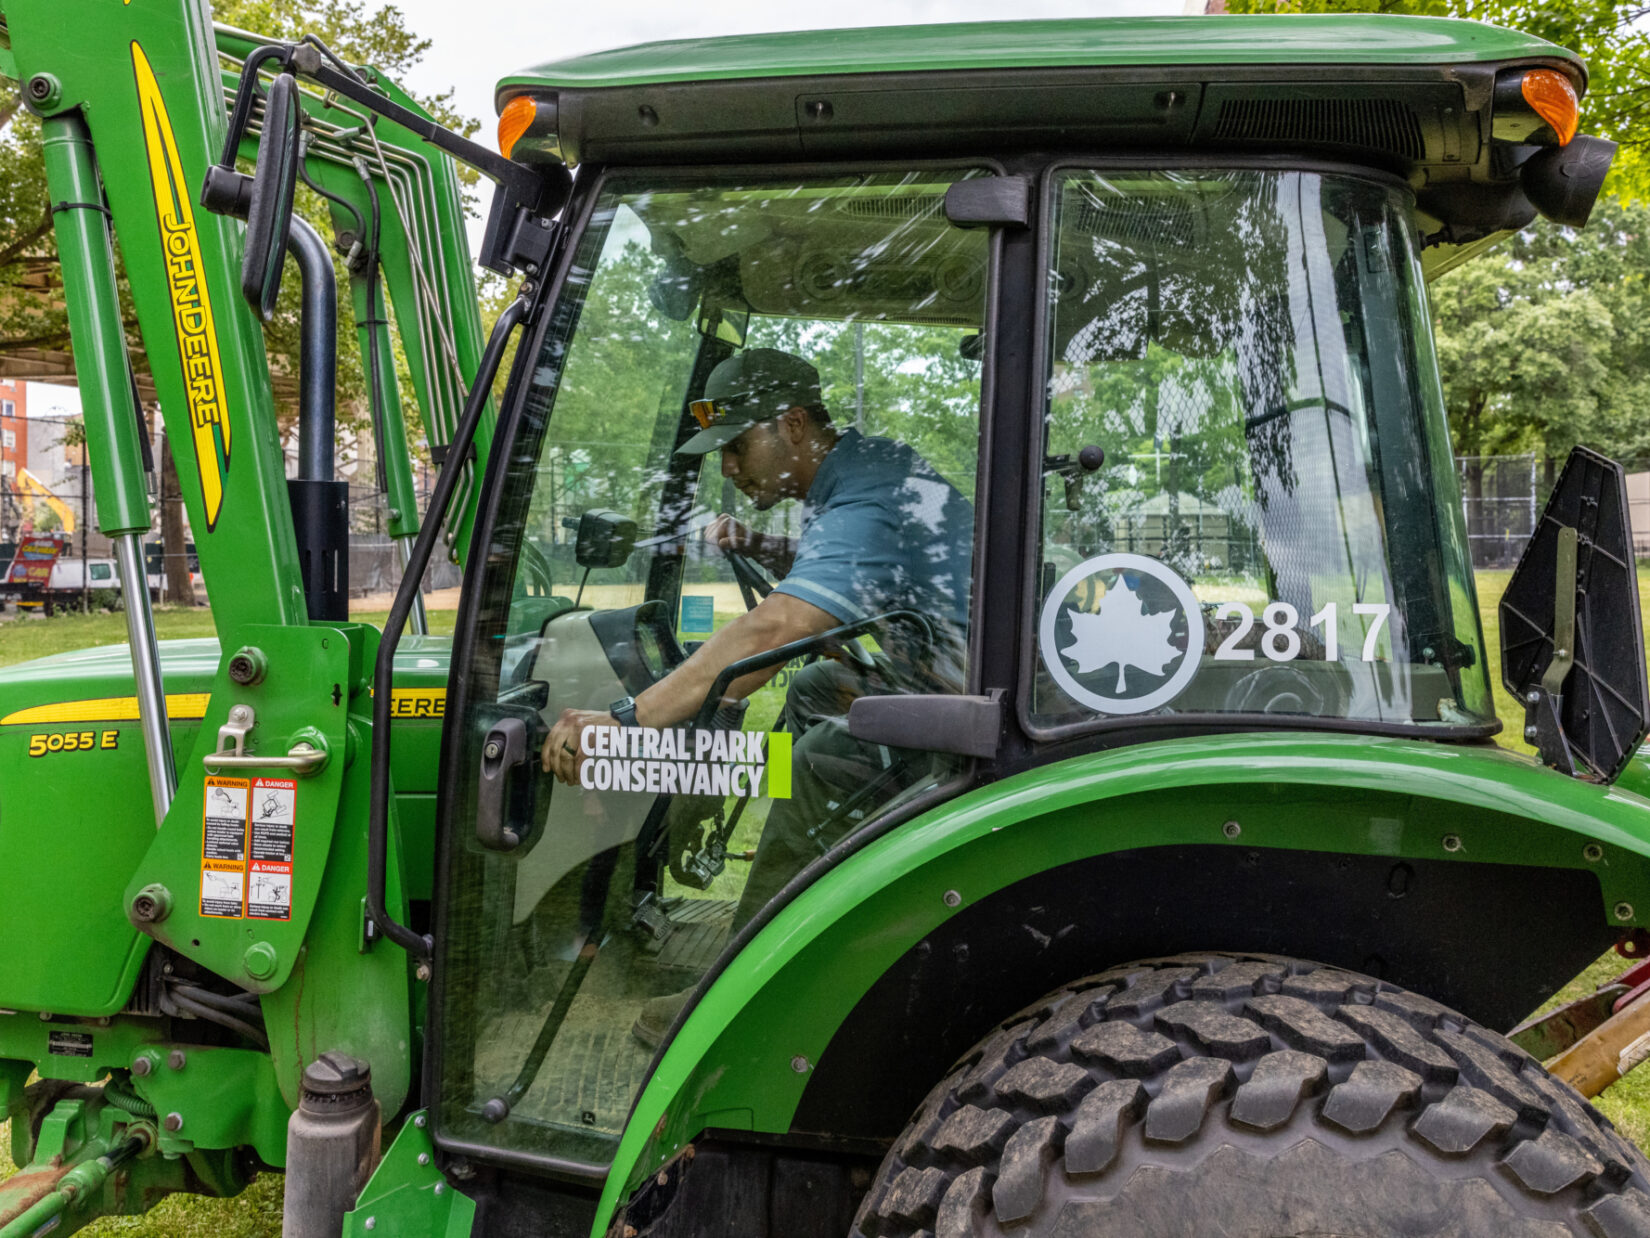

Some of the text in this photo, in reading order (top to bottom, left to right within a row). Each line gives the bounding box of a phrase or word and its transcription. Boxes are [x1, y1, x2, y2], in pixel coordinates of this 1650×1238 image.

[162, 212, 221, 428] JOHN DEERE
[1213, 601, 1391, 663] 2817
[29, 729, 120, 758] 5055 E
[580, 724, 765, 764] CENTRAL PARK
[216, 779, 248, 787] WARNING
[579, 757, 765, 799] CONSERVANCY
[212, 863, 244, 871] WARNING
[261, 864, 290, 872] DANGER
